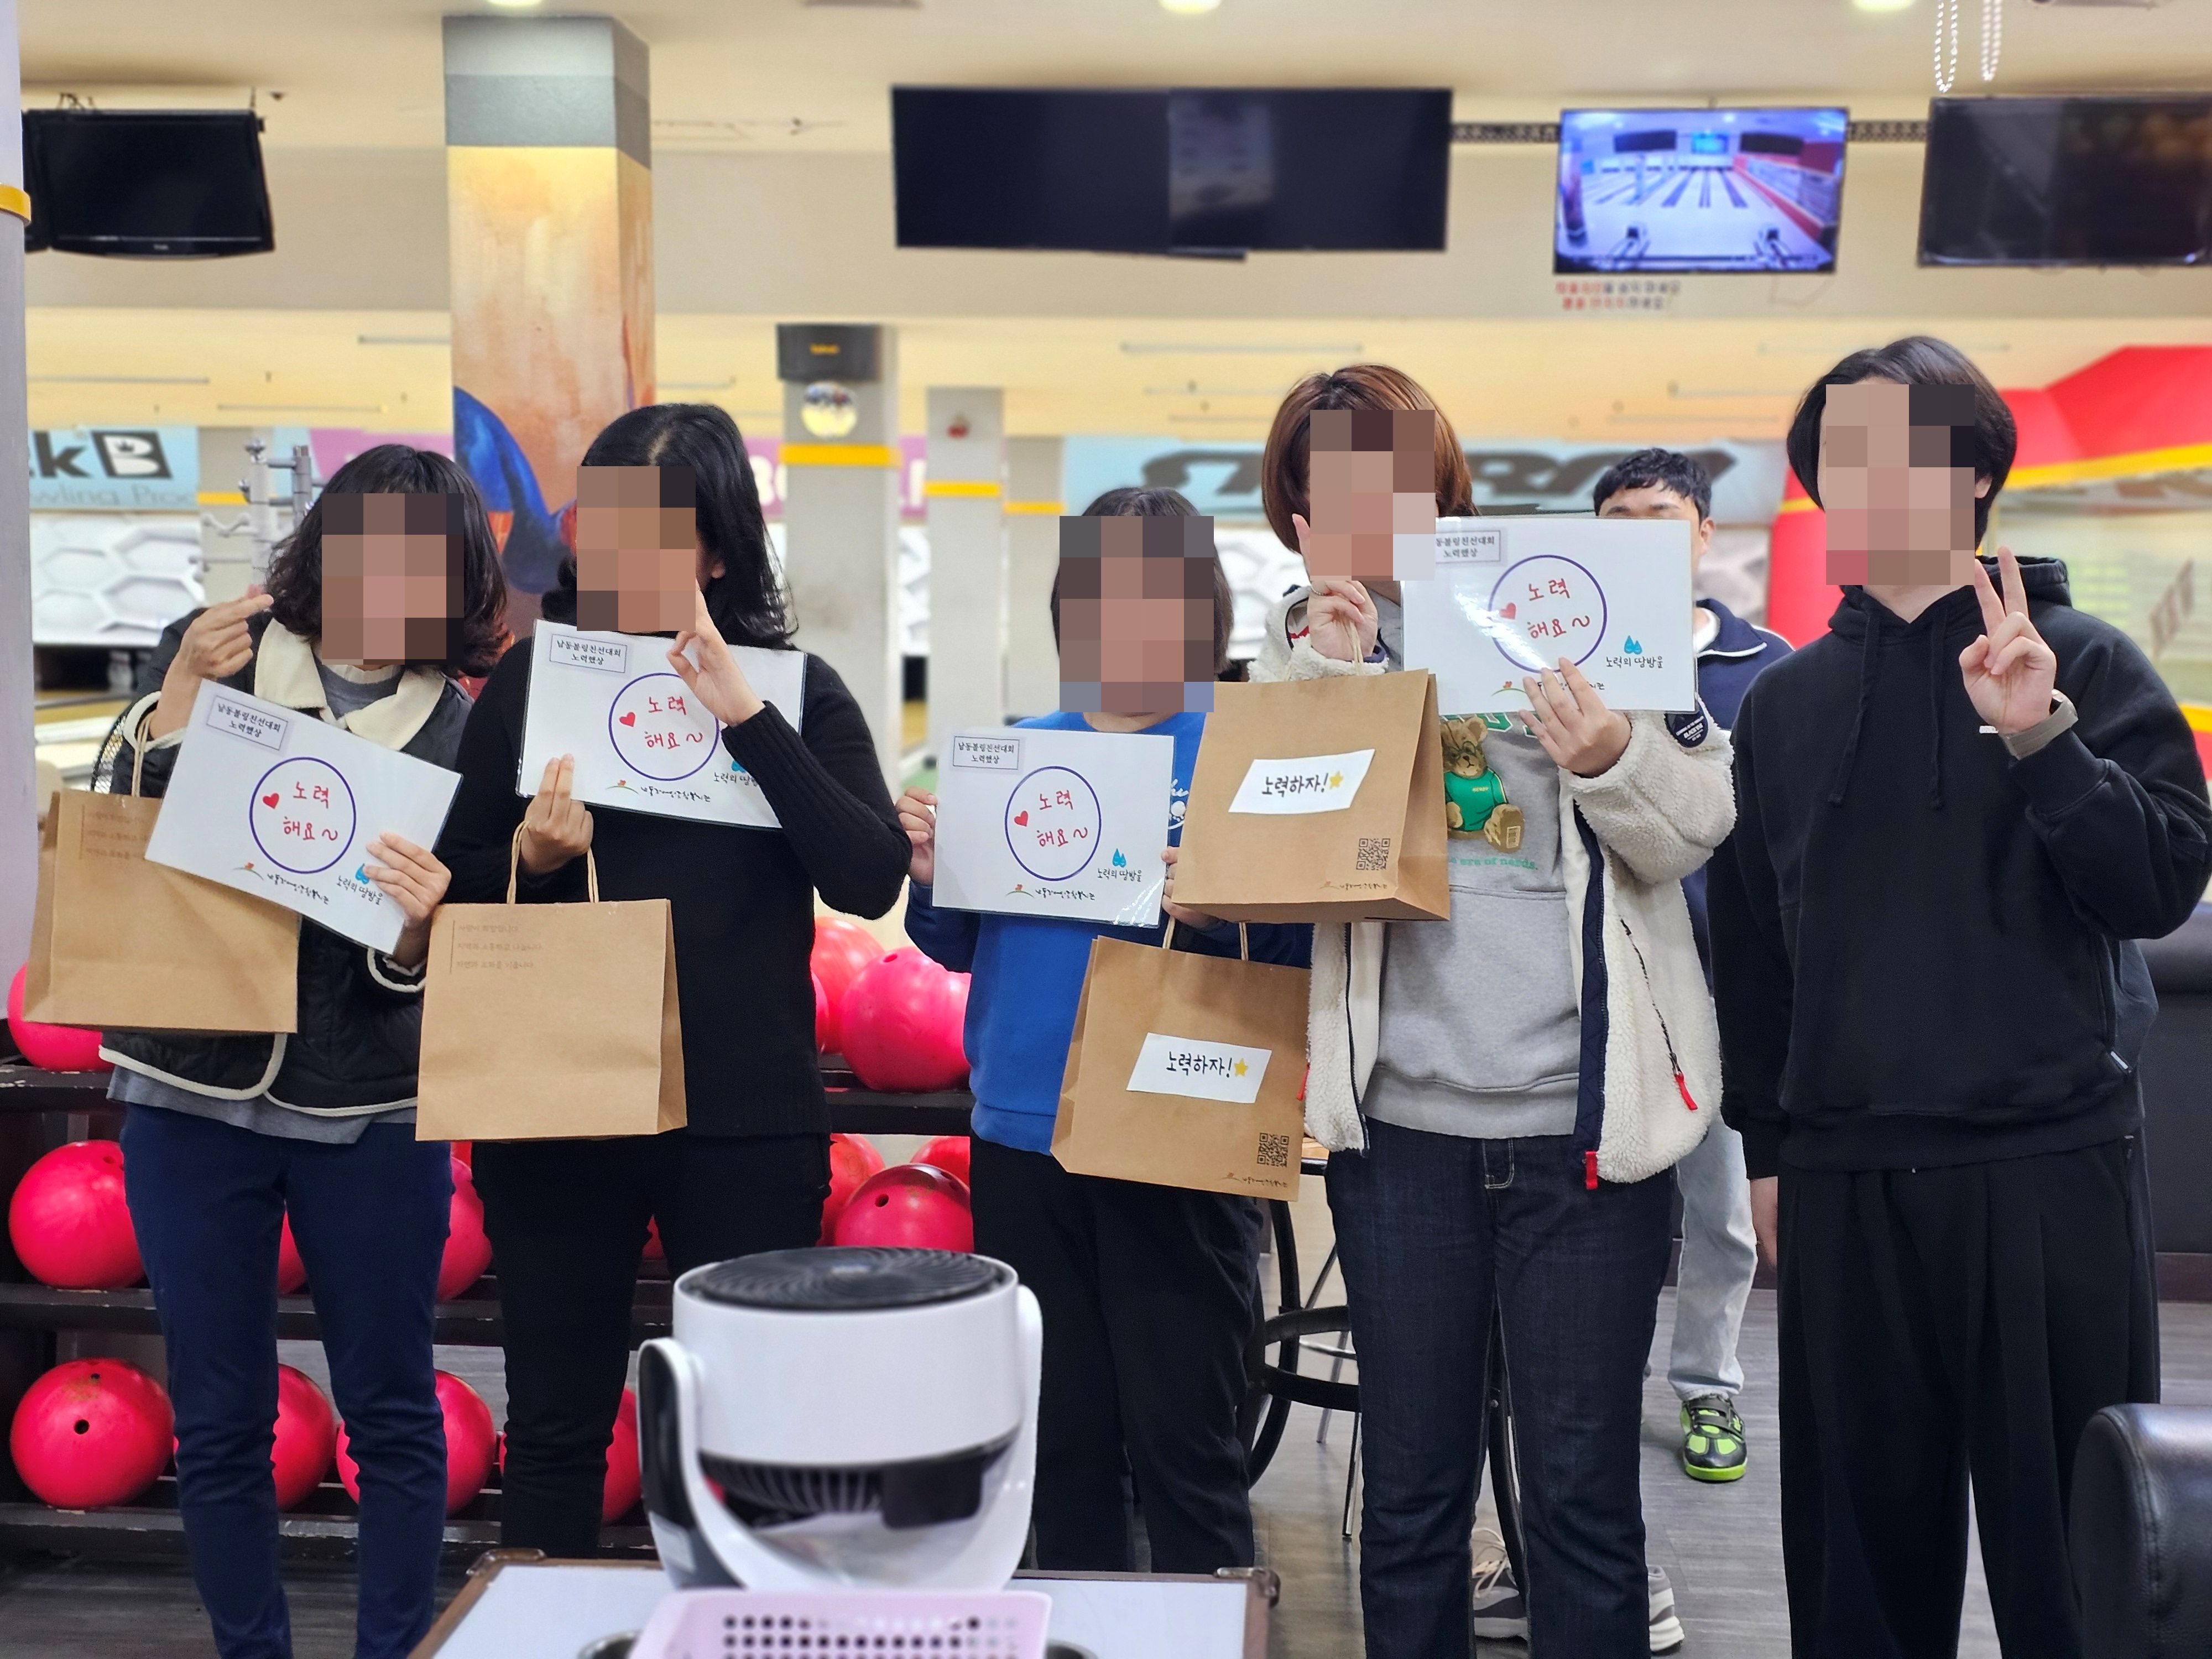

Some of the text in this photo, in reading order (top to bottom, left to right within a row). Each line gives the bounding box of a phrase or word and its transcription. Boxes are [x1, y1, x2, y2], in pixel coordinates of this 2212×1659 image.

[28, 430, 92, 479] k
[1528, 578, 1571, 602] 노력
[648, 696, 687, 716] 노력
[293, 781, 329, 808] 노력
[1261, 773, 1329, 797] 노력하자!
[1039, 790, 1073, 810] 노력
[1166, 1051, 1233, 1078] 노력하자!
